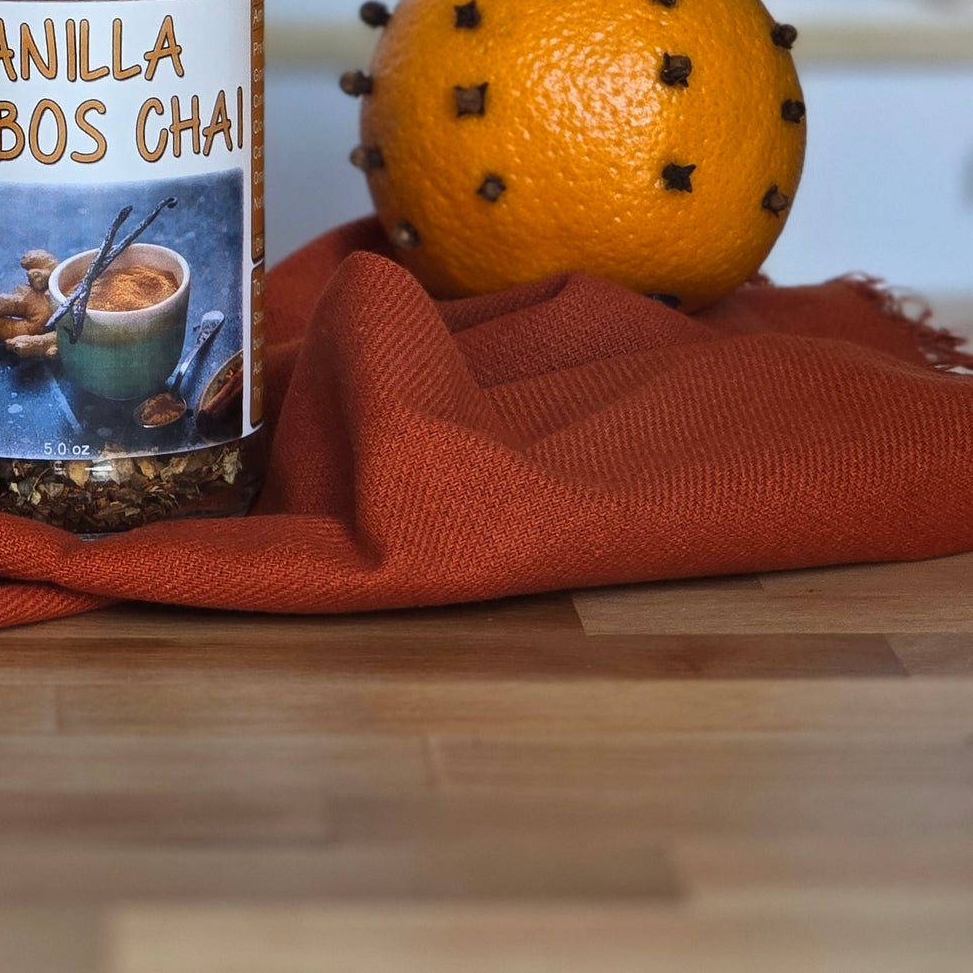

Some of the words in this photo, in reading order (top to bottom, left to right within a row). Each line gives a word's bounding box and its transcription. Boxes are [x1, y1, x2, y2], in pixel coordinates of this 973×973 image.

[135, 85, 244, 164] CHAI
[43, 442, 67, 456] 5.0
[72, 444, 90, 456] oz
